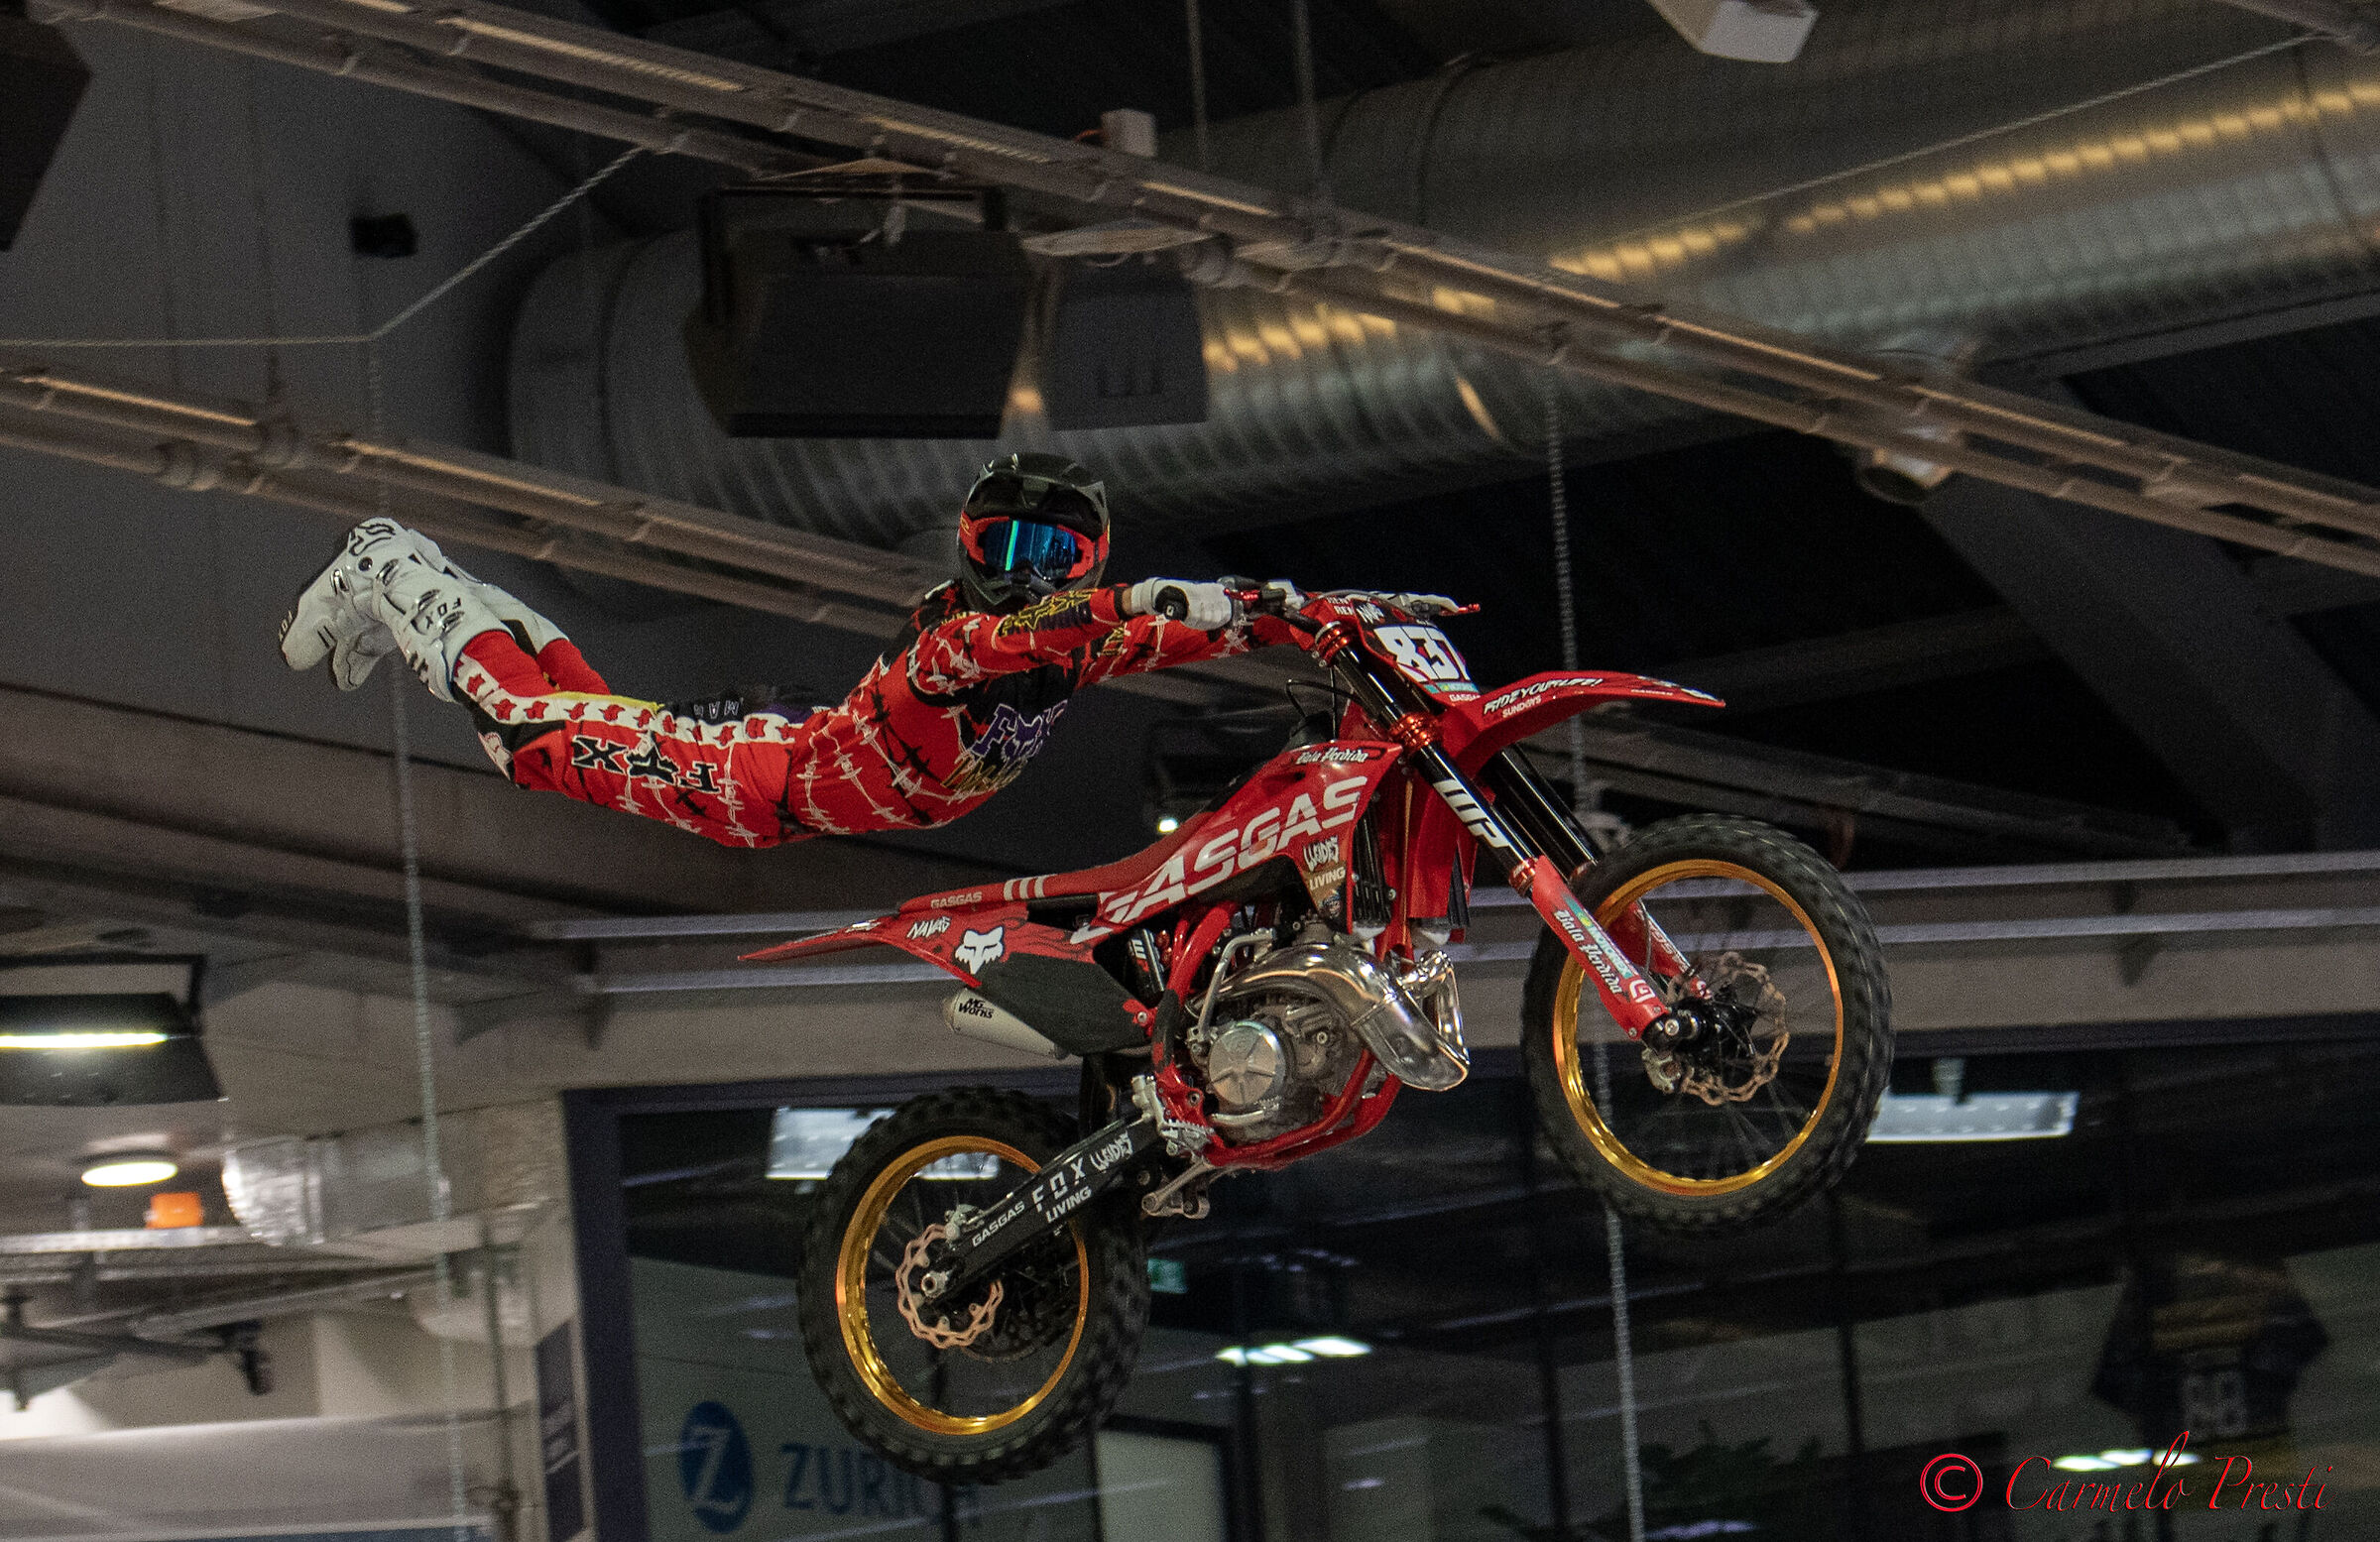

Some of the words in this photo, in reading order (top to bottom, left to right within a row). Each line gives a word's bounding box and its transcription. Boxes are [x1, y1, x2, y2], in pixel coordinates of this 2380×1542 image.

[1309, 866, 1347, 890] LIVING
[930, 891, 983, 909] GASGAS
[1046, 1186, 1092, 1223] LIVING
[972, 1201, 1025, 1246] GASGAS
